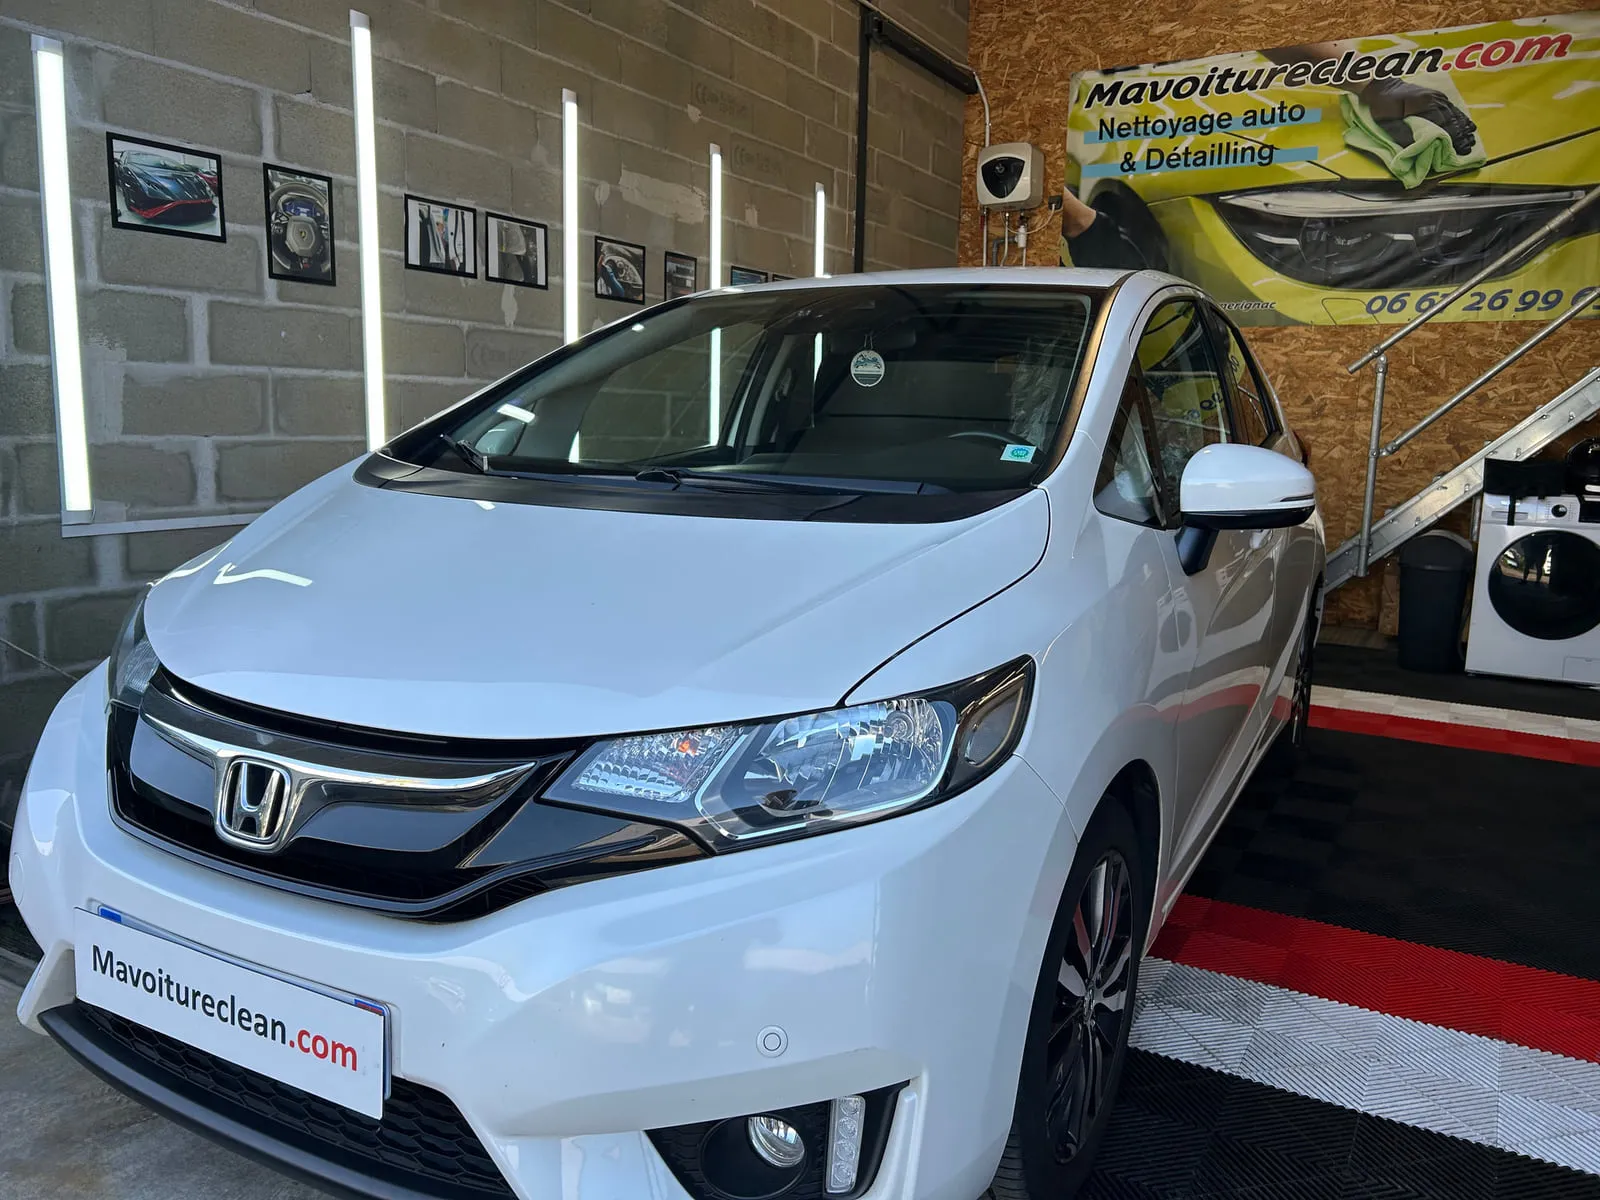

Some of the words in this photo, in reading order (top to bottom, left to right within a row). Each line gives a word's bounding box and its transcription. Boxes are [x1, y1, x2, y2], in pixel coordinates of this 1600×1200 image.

[1084, 33, 1573, 109] Mavoitureclean.com
[1098, 110, 1233, 141] Nettoyage
[1241, 100, 1306, 126] auto
[1120, 151, 1137, 173] &
[1145, 141, 1275, 171] Détailling
[1365, 292, 1411, 315] 06
[1462, 288, 1513, 312] 26
[1514, 289, 1564, 312] 99
[91, 944, 358, 1072] Mavoitureclean.com
